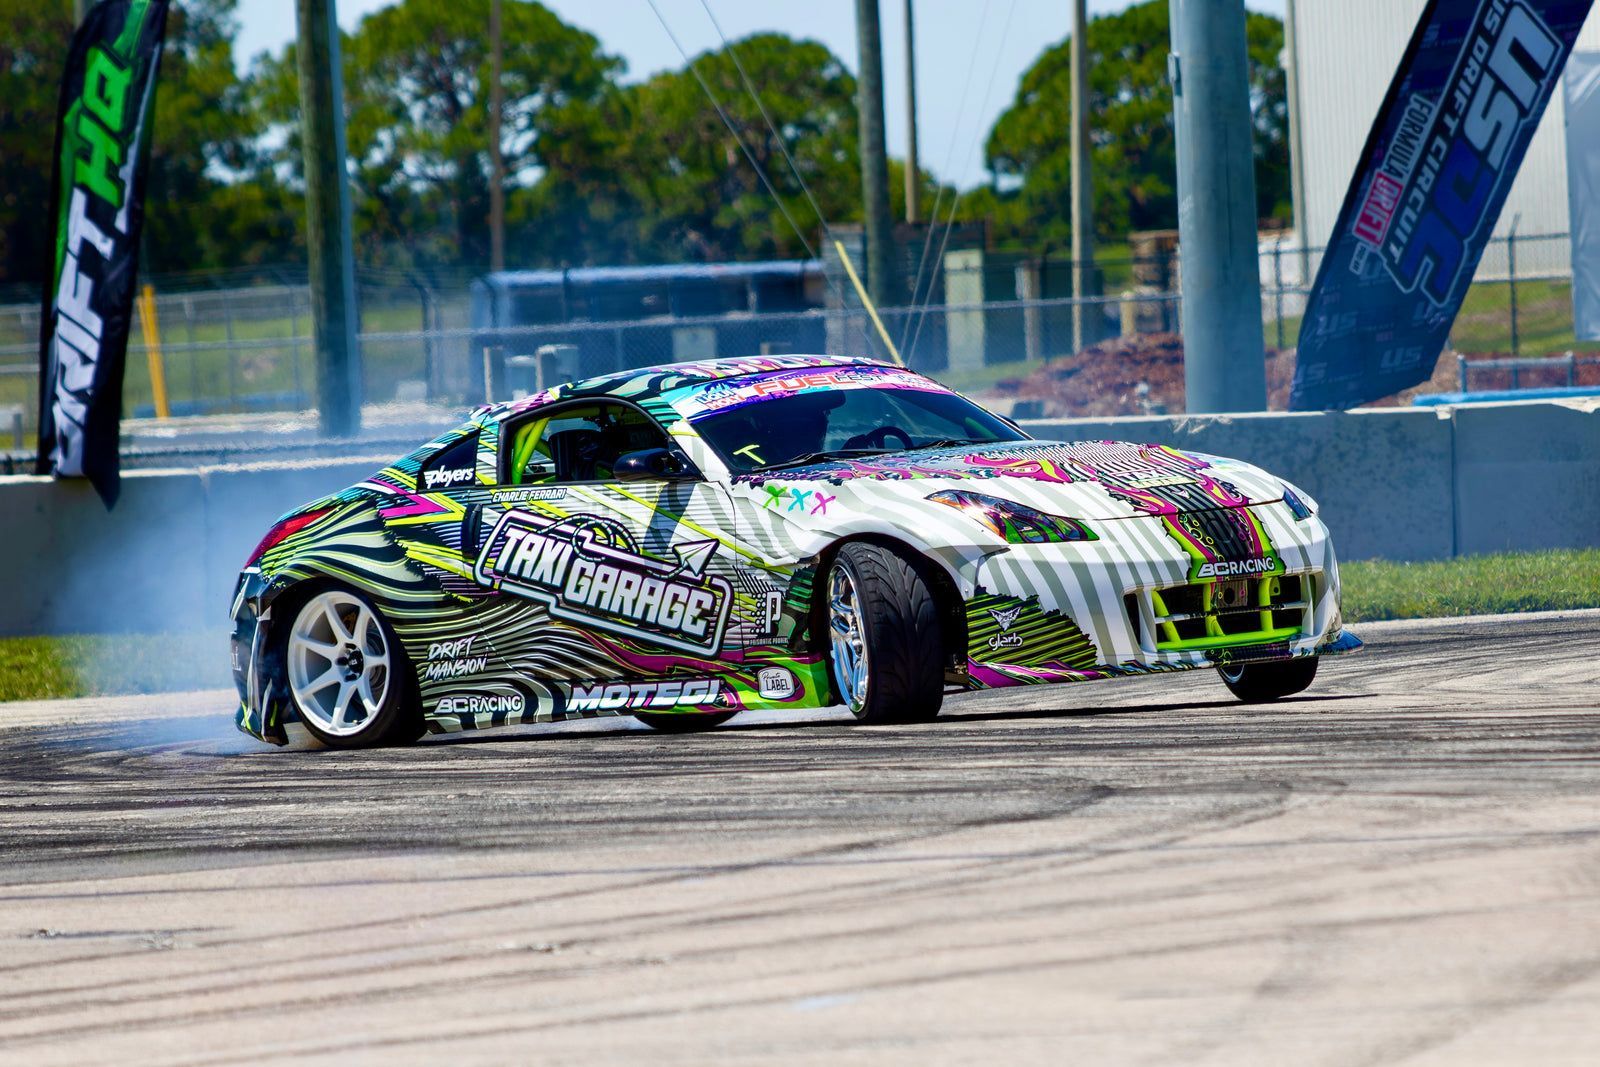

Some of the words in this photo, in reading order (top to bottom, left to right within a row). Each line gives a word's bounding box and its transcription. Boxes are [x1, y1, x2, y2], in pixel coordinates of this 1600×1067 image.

[1443, 36, 1490, 136] DRIFT
[1383, 95, 1434, 181] FORMULA
[1358, 176, 1399, 243] DRIFT
[1389, 135, 1447, 265] CIRCUIT
[424, 465, 474, 489] players
[492, 490, 528, 503] CHARLIE
[529, 488, 567, 501] FERRARI
[495, 527, 574, 587] TAXI
[563, 558, 716, 637] GARAGE
[425, 657, 488, 681] MANSION
[427, 635, 476, 660] DRIFT
[566, 679, 720, 712] MOTEGI
[765, 678, 791, 691] LABEL
